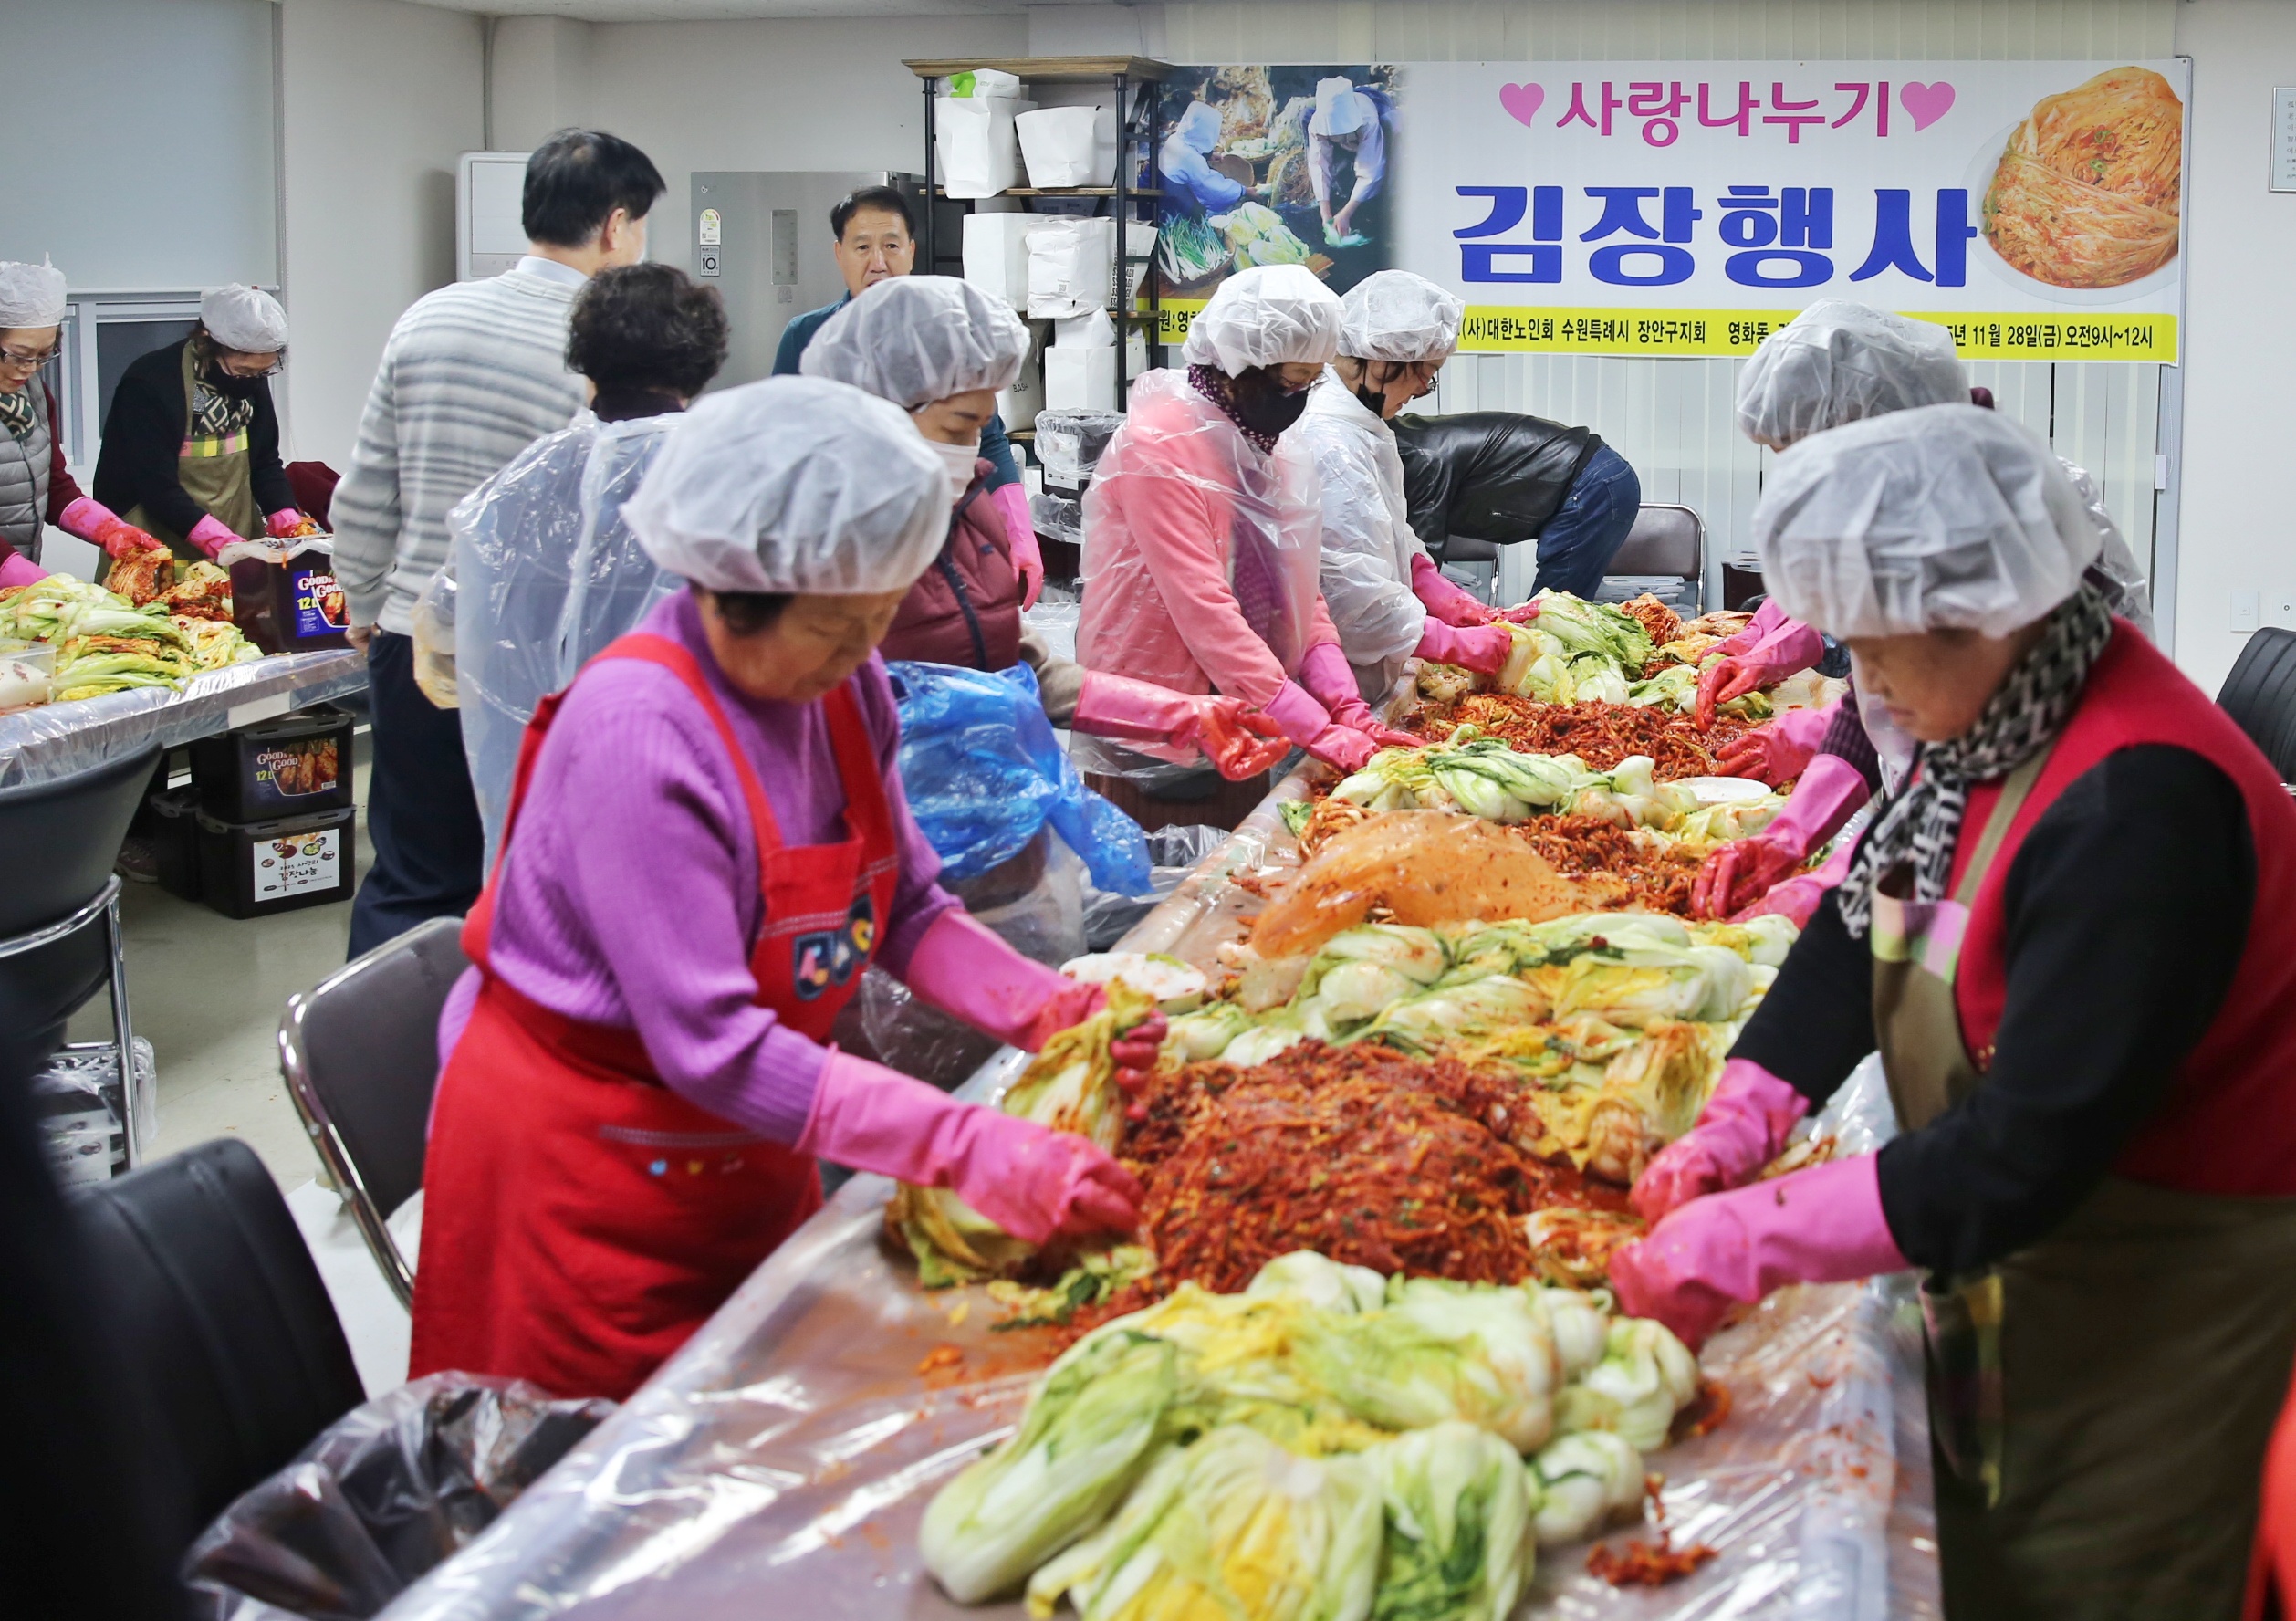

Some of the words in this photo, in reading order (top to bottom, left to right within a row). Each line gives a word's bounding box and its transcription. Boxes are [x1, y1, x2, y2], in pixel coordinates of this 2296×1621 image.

[1557, 81, 1889, 147] 사랑나누기
[1454, 185, 1978, 288] 김장행사
[1462, 317, 1554, 341] (사)대한노인회
[1561, 318, 1629, 343] 수원특례시
[1637, 319, 1706, 344] 장안구지회
[1728, 321, 1769, 345] 영화동
[1972, 323, 2001, 348] 11월
[2007, 324, 2061, 348] 28일(금)
[2065, 325, 2153, 349] 오전9시~12시
[272, 758, 298, 770] GOOD
